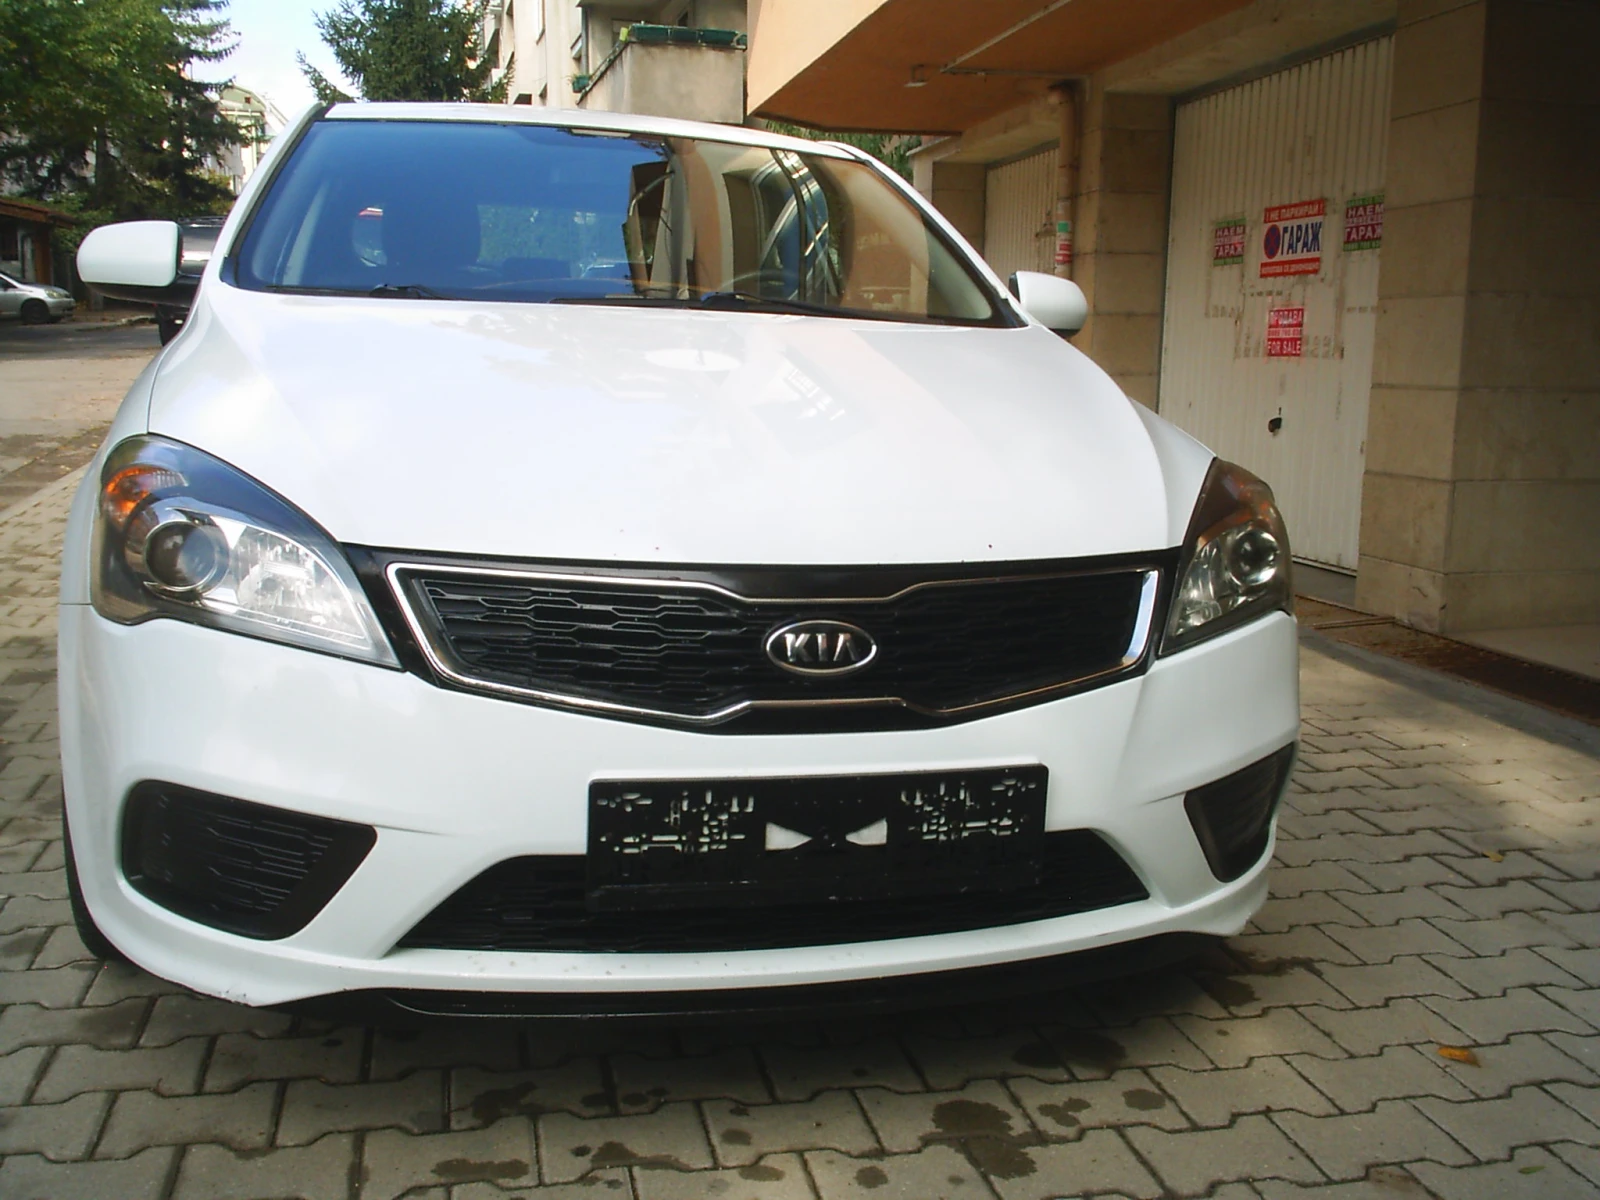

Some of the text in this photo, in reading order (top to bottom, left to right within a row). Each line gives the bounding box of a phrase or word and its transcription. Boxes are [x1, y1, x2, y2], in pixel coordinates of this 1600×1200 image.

[1347, 203, 1384, 218] НАЕМ
[1281, 221, 1323, 256] ГАРАЖ
[1267, 340, 1301, 354] FOR SALE
[784, 632, 861, 662] KIA
